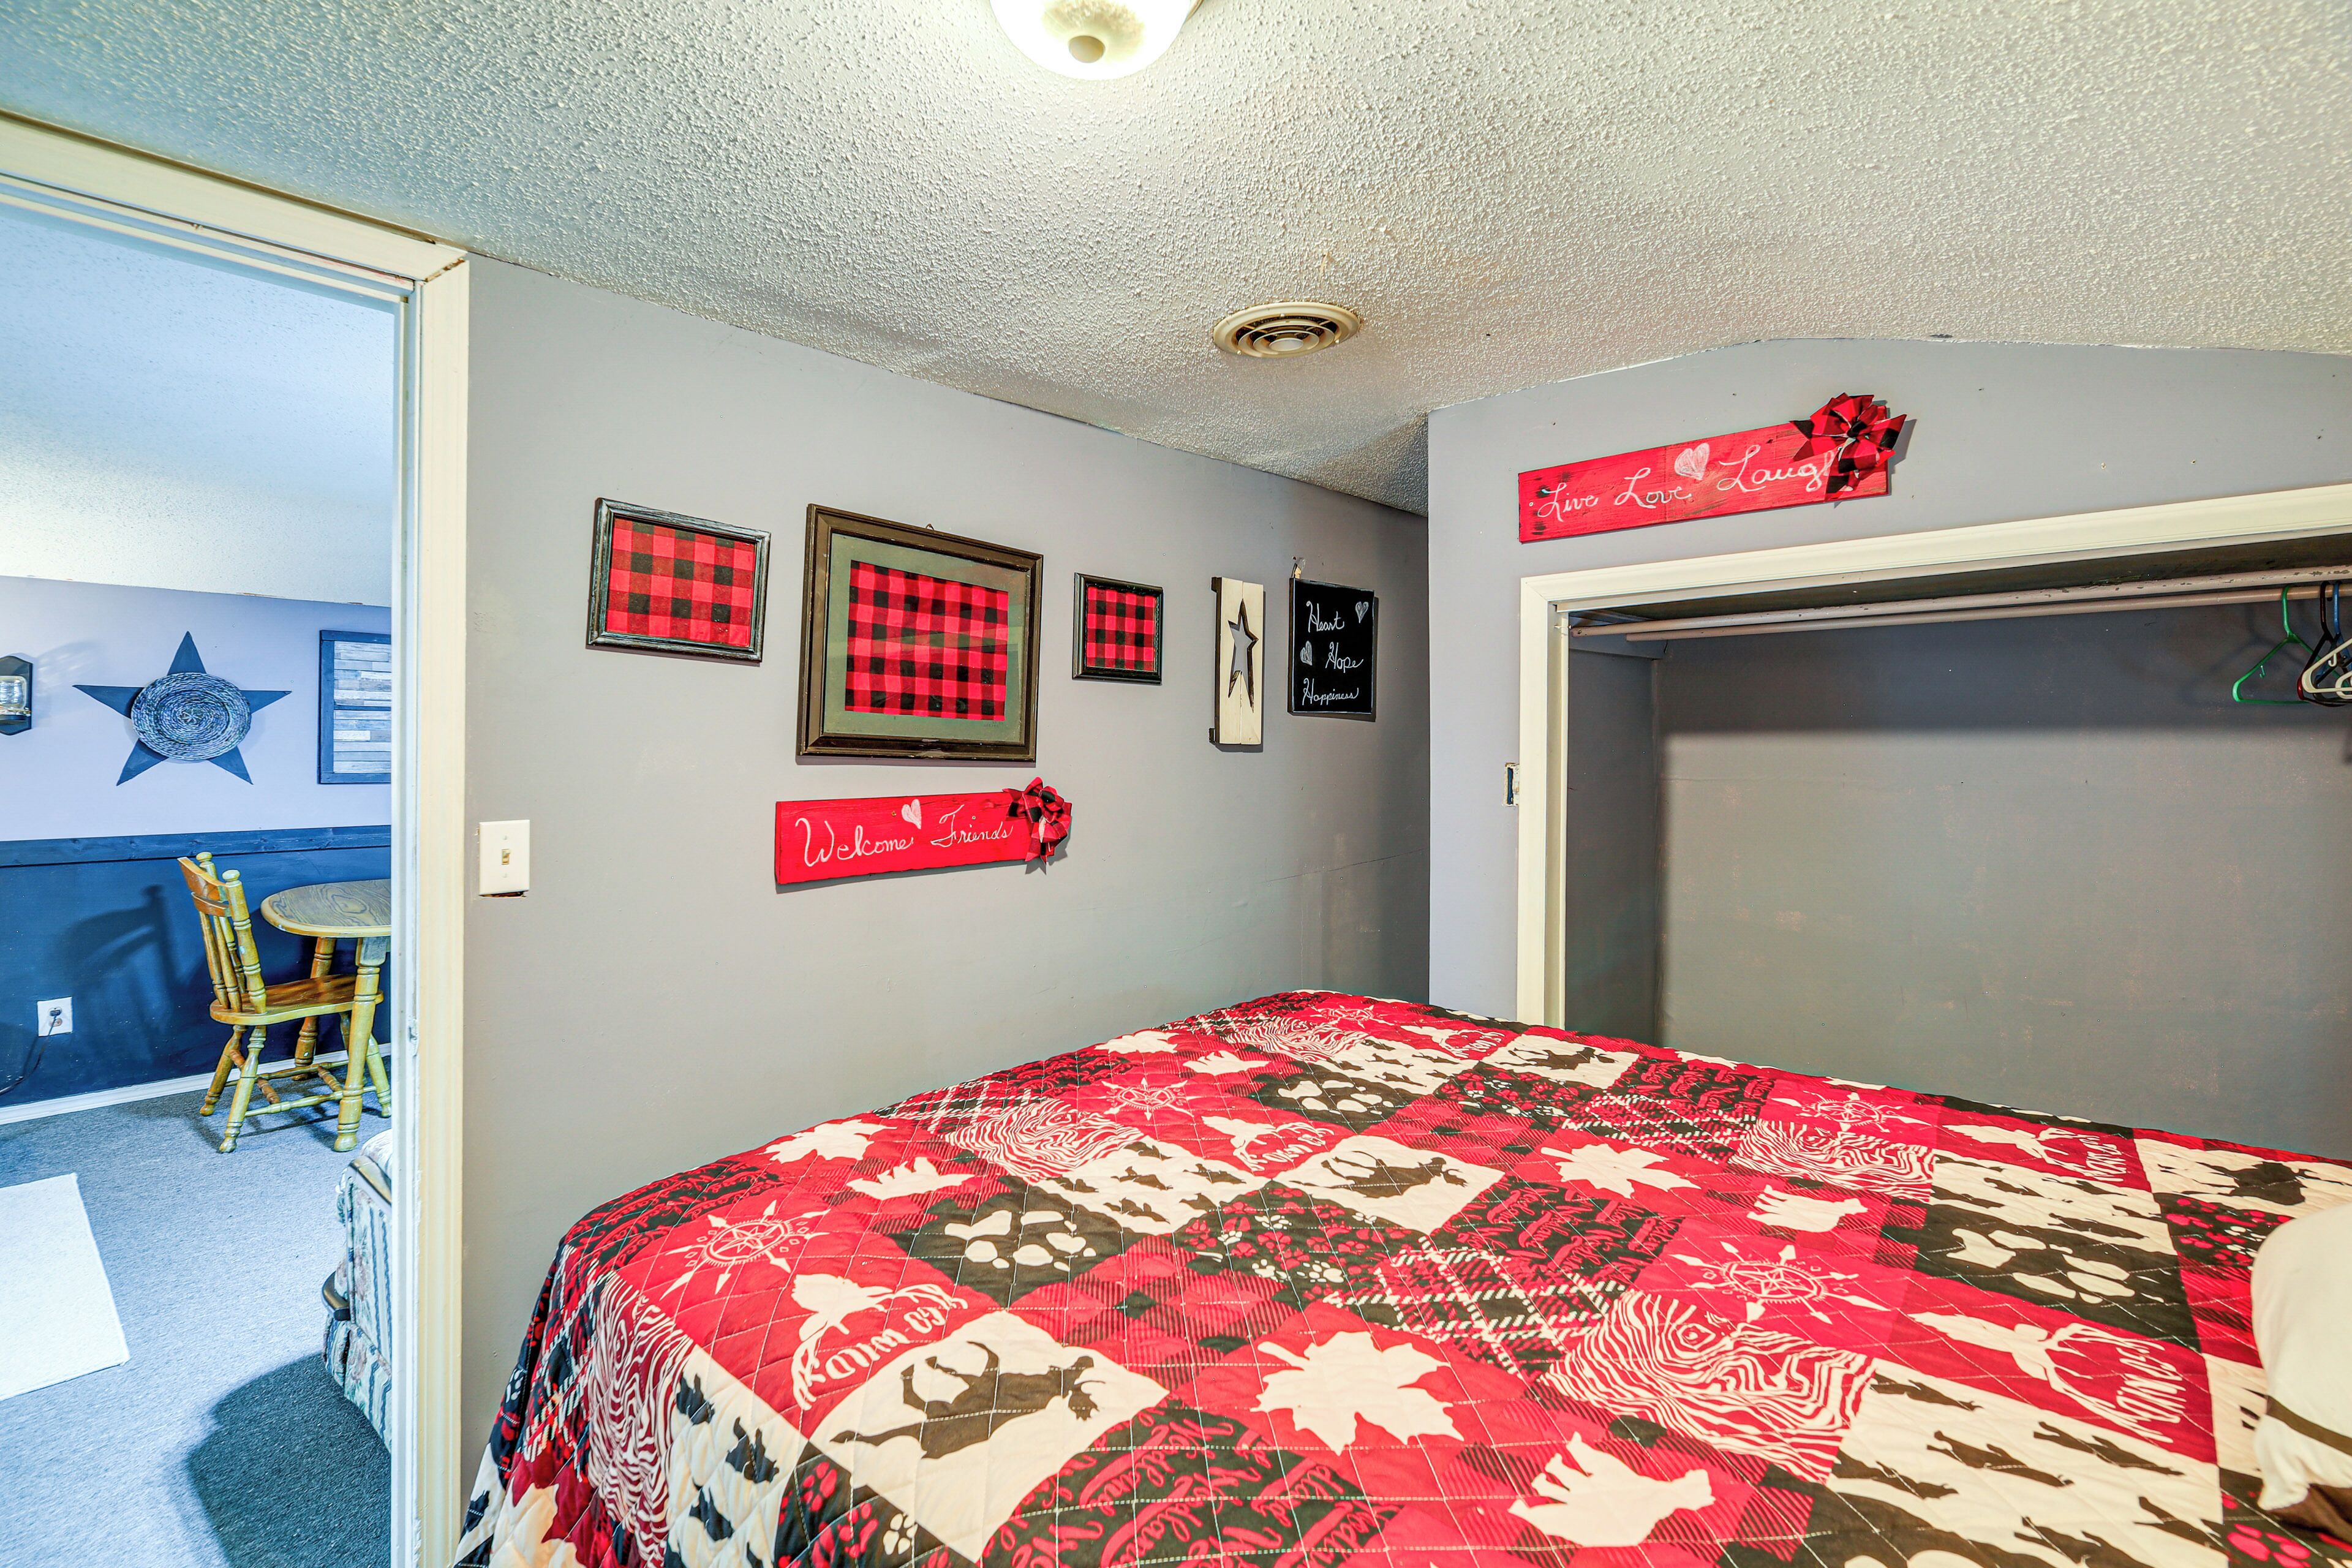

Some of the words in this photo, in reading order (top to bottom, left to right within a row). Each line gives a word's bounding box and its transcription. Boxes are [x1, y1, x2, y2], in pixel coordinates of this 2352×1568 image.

[1538, 481, 1599, 522] Live
[1615, 467, 1692, 509] Love
[1306, 600, 1345, 633] Heart
[1325, 641, 1364, 674] Hope
[1302, 677, 1359, 706] Happiness
[796, 817, 914, 867] Welcome
[930, 804, 1014, 848] Friends
